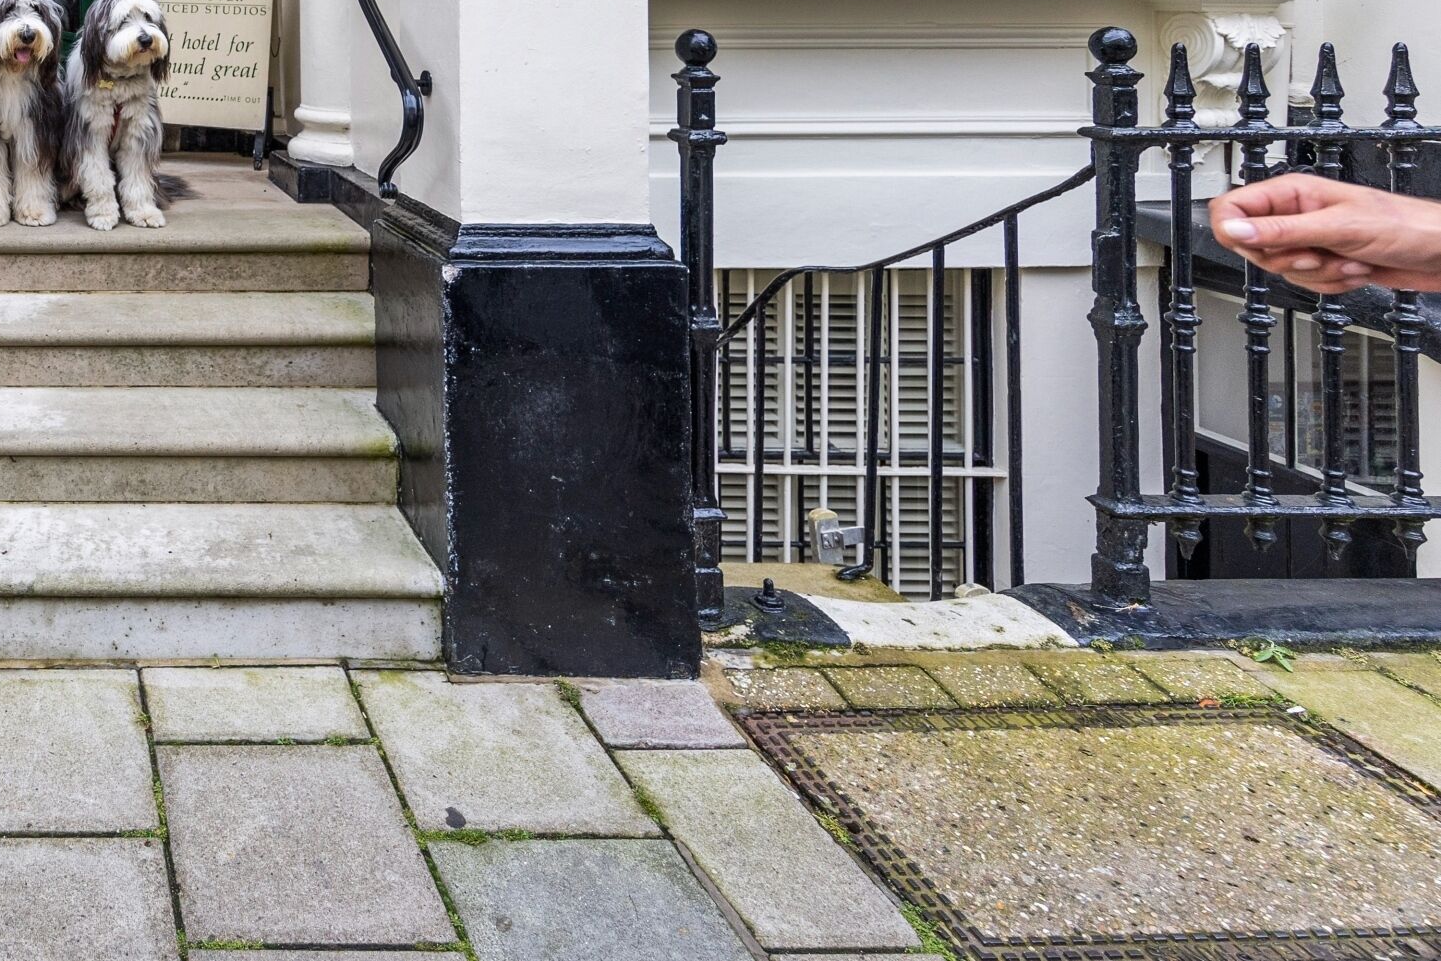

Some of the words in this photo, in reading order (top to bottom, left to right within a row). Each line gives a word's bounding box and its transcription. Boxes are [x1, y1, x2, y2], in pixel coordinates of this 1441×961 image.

[205, 4, 267, 16] STUDIOS
[181, 31, 221, 51] hotel
[227, 33, 255, 56] for
[211, 62, 258, 81] great
